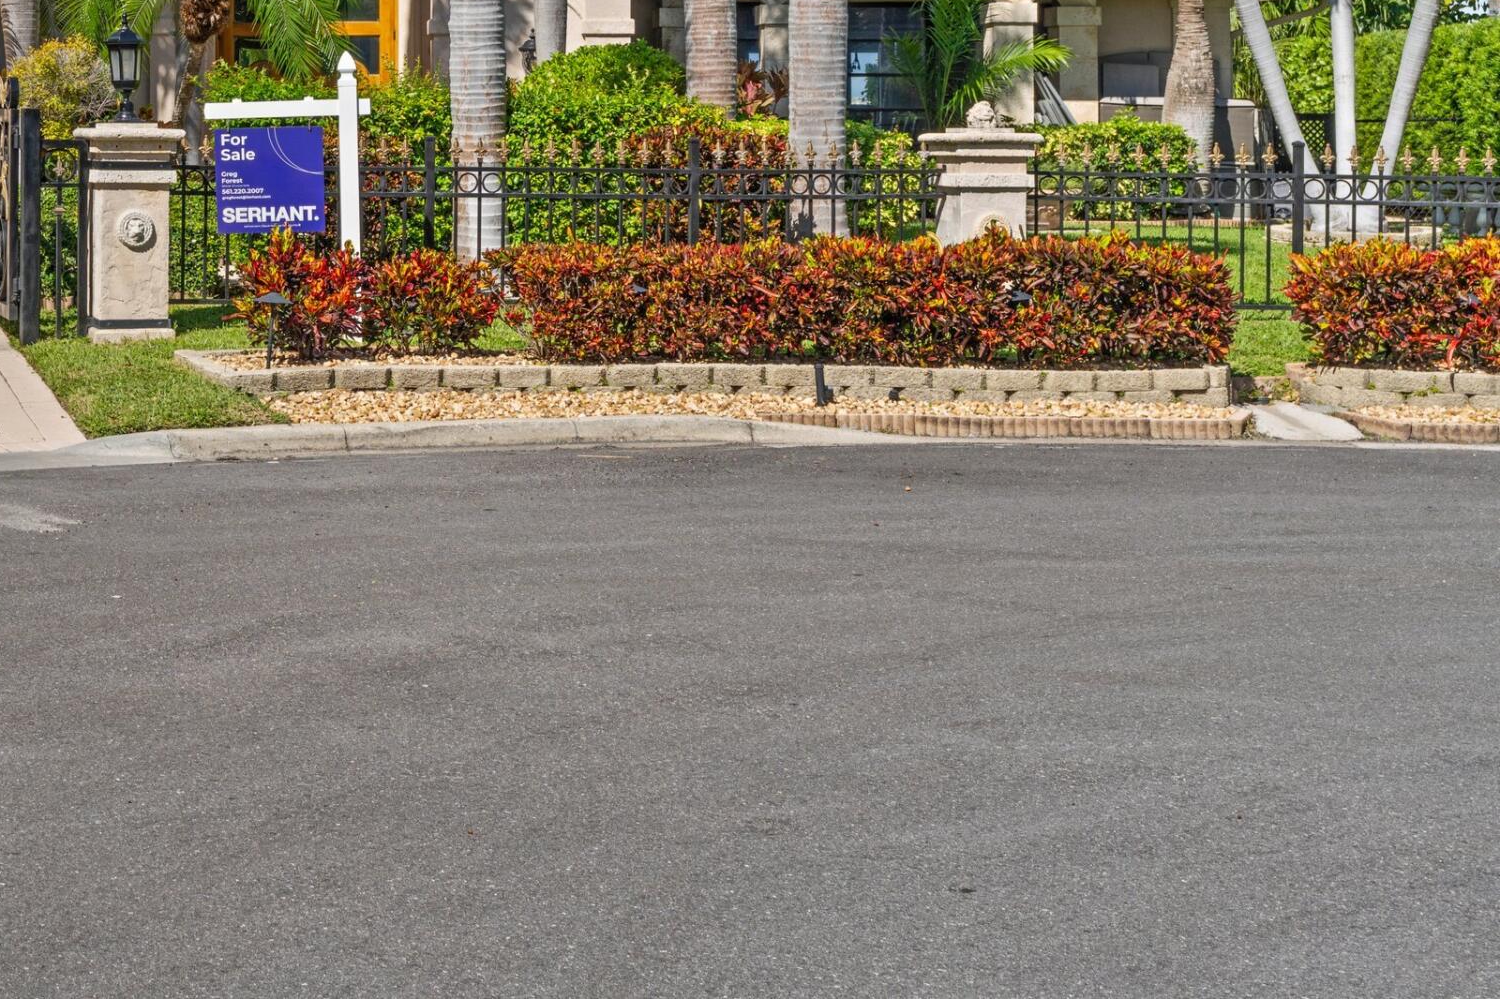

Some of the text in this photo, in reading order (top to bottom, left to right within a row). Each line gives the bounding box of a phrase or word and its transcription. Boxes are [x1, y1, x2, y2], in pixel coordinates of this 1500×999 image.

[220, 134, 248, 146] For
[220, 148, 256, 161] Sale
[222, 206, 320, 224] SERHANT.
